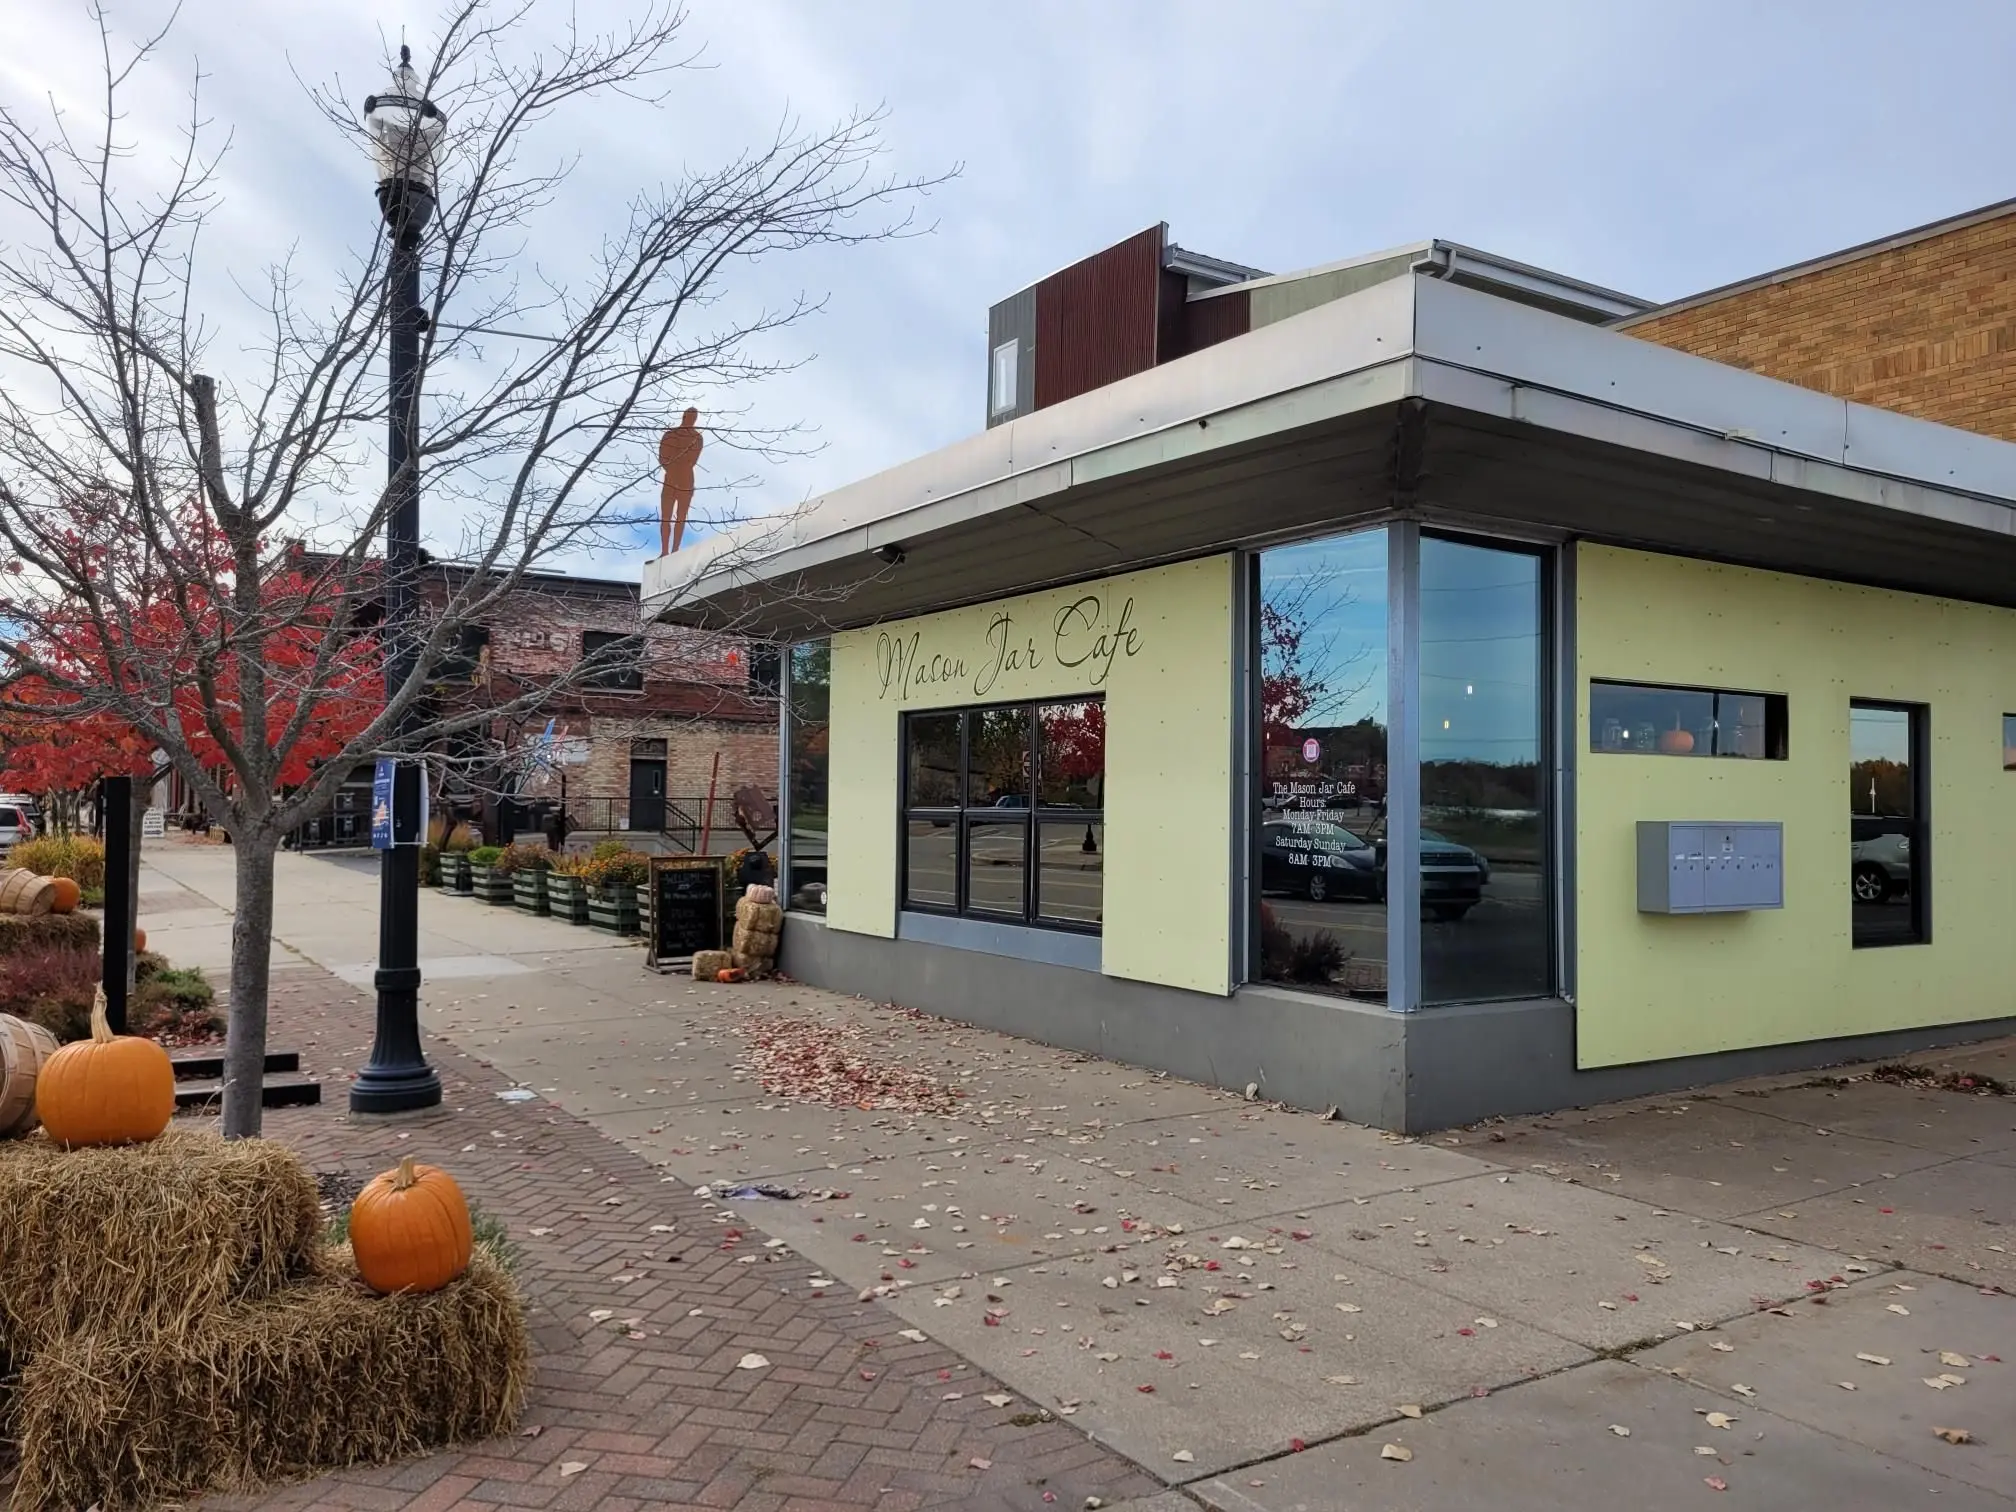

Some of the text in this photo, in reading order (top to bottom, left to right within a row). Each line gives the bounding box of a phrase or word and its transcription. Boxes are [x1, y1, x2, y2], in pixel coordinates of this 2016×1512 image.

[876, 595, 1144, 700] Mason Jar Cafe
[1273, 781, 1356, 794] The Mason Jar Cafe
[1299, 797, 1327, 808] Hours:
[1315, 823, 1335, 835] 3PM
[1312, 855, 1332, 868] 3PM
